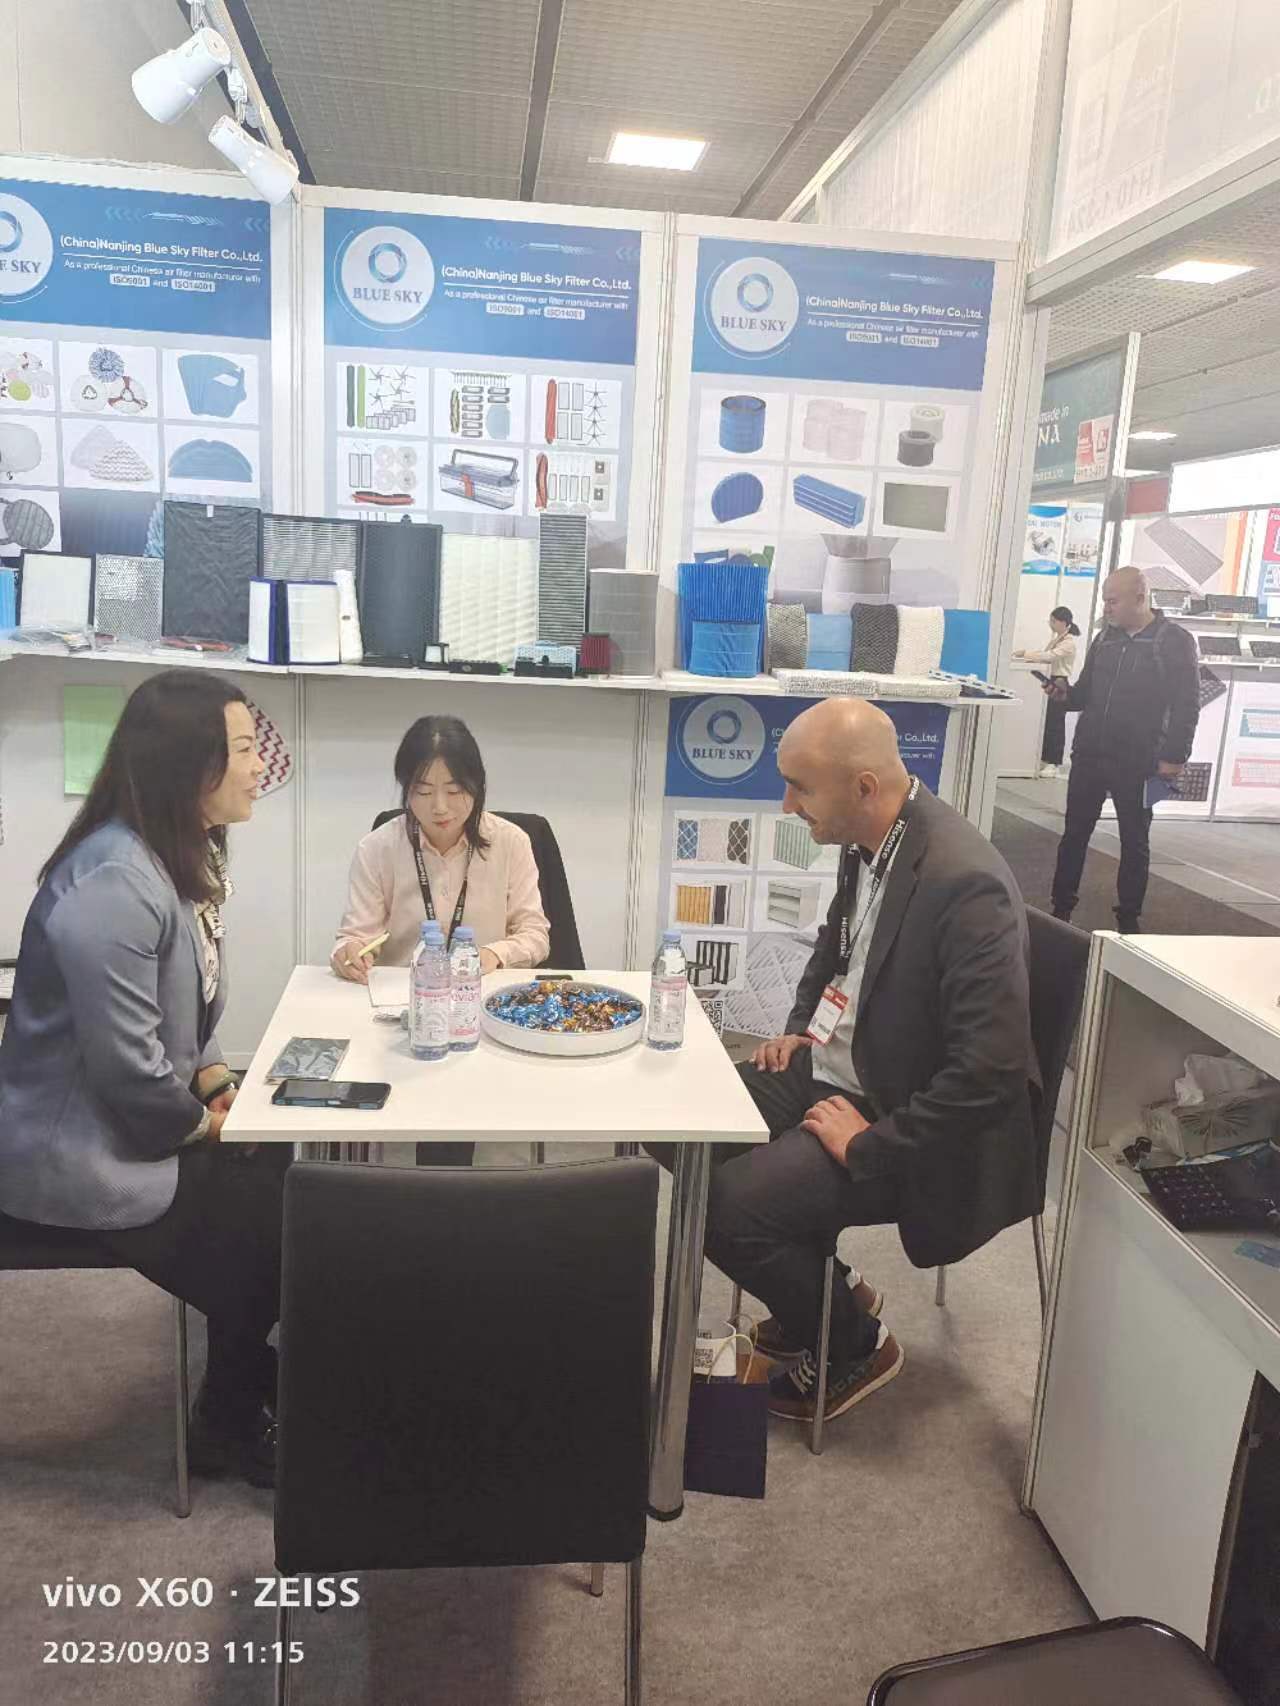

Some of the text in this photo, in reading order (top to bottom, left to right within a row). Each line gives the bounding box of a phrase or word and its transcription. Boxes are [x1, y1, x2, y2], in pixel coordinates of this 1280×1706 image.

[144, 242, 168, 254] Blue
[170, 244, 190, 258] Sky
[191, 246, 219, 258] Filter
[221, 249, 263, 262] Co.,Ltd.
[11, 259, 41, 273] SKY
[520, 271, 543, 283] Blue
[544, 274, 563, 287] Sky
[565, 275, 590, 287] Filter
[592, 277, 632, 290] Co.,Ltd.
[352, 287, 423, 304] BLUE SKY
[880, 301, 900, 312] Blue
[902, 303, 919, 317] Sky
[921, 305, 945, 316] Filter
[721, 316, 786, 332] BLUE SKY
[692, 747, 755, 761] BLUE SKY
[880, 818, 906, 859] Hisense
